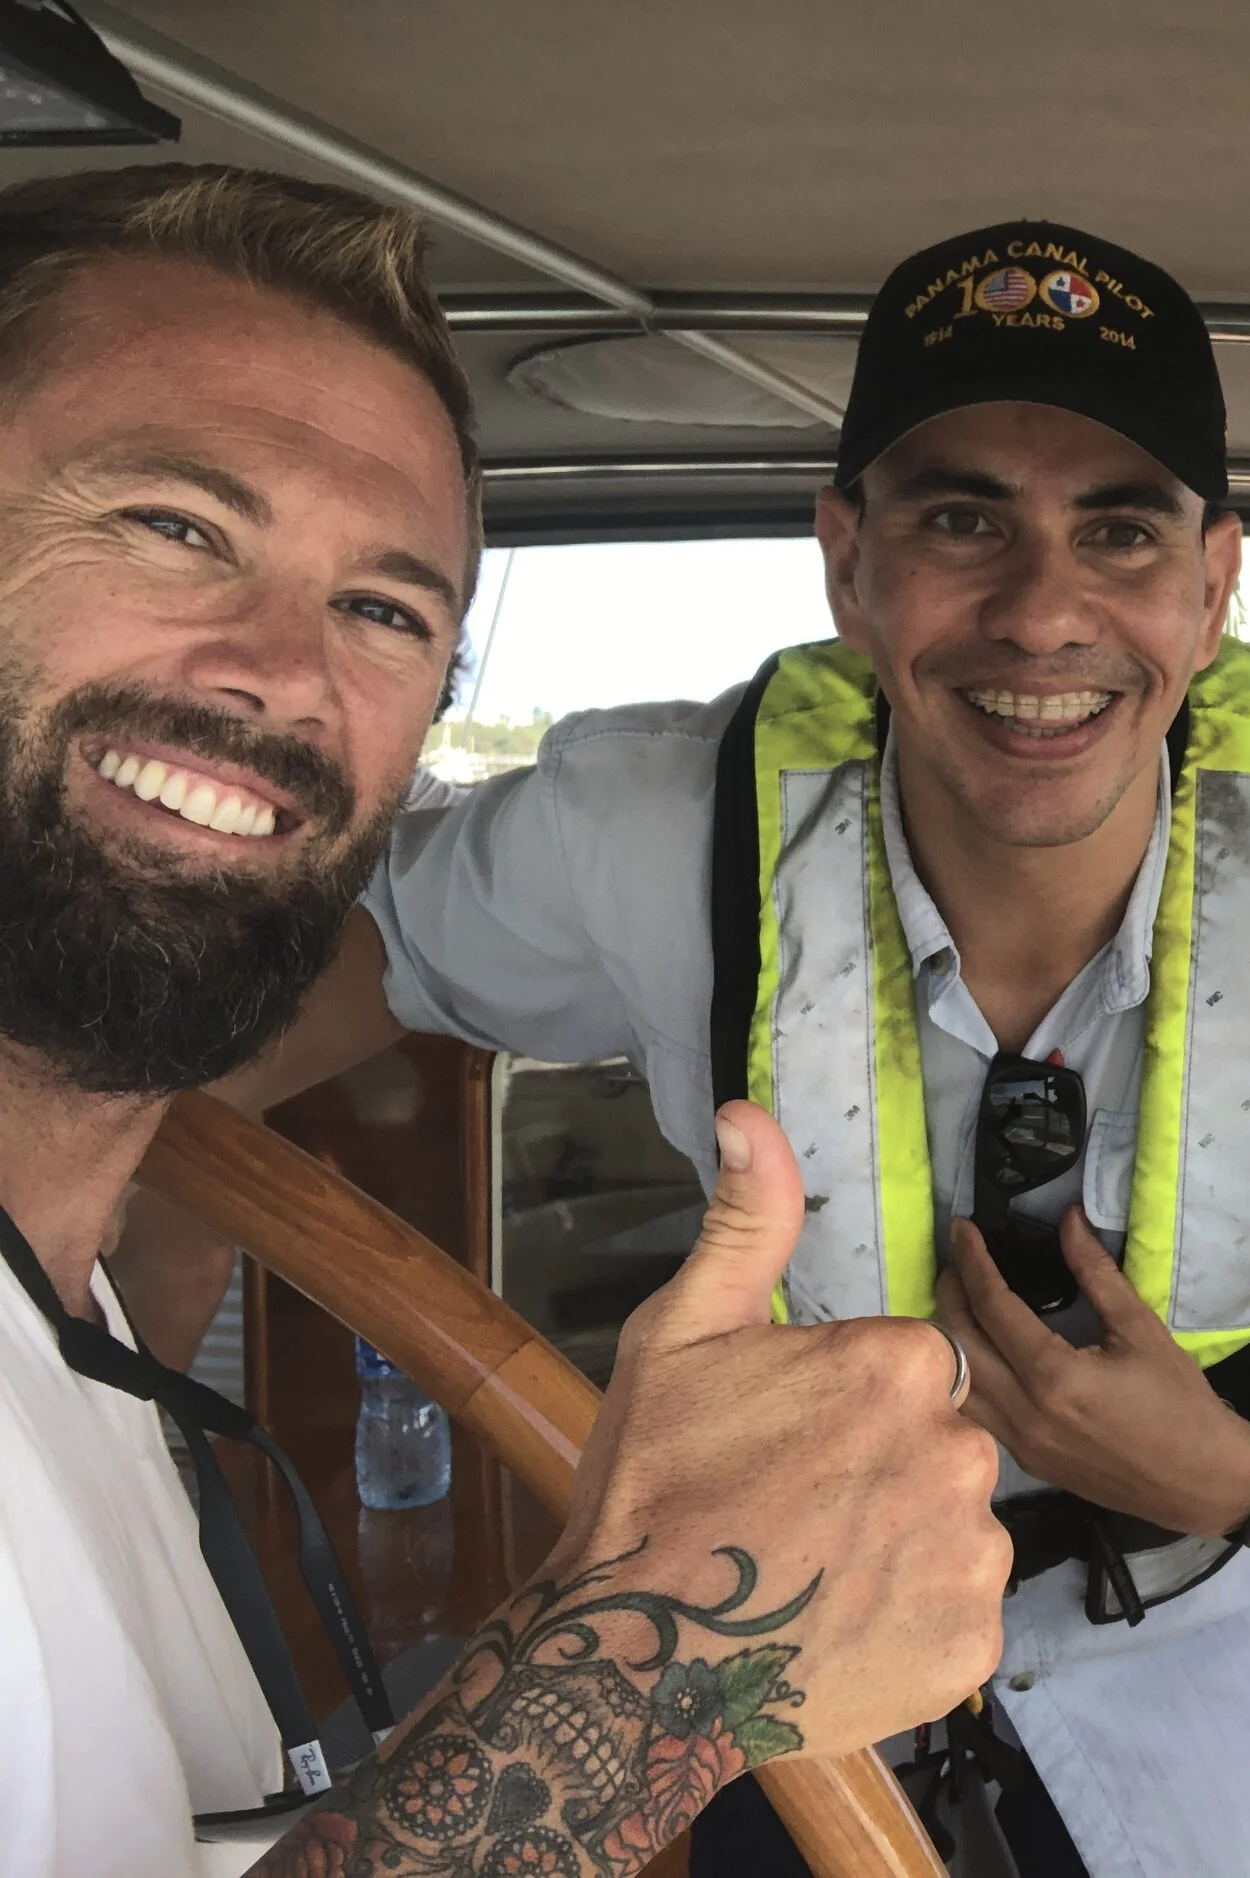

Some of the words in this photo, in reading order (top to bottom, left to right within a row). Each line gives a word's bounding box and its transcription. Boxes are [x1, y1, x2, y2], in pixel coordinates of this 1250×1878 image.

[904, 248, 1000, 319] PANAMA
[1006, 240, 1089, 278] CANAL
[1095, 269, 1155, 319] PILOT
[991, 311, 1066, 332] YEARS
[1098, 325, 1137, 350] 2014
